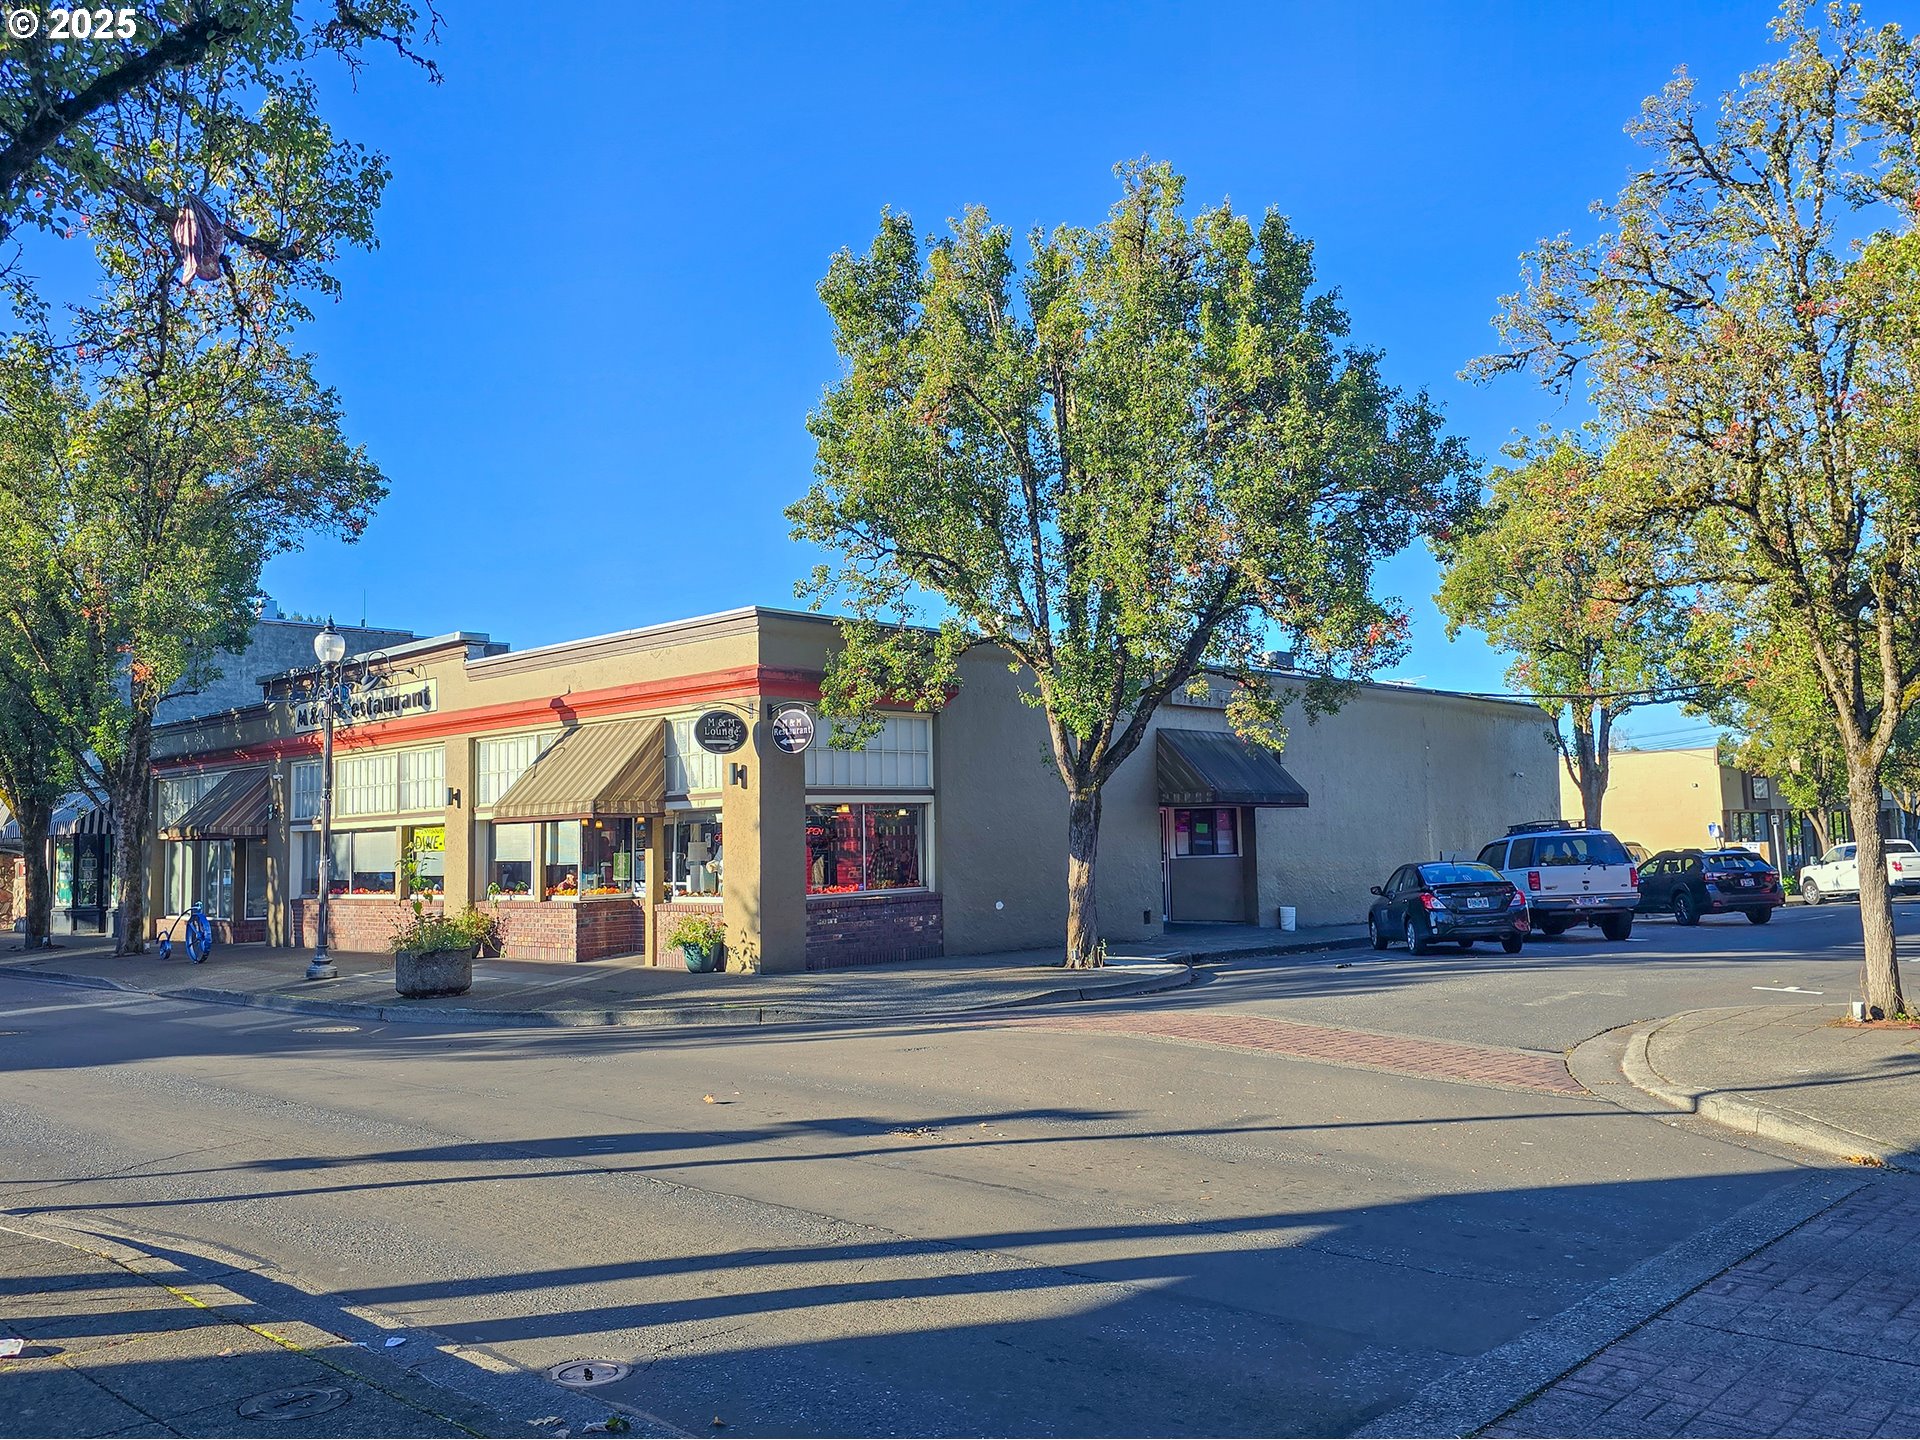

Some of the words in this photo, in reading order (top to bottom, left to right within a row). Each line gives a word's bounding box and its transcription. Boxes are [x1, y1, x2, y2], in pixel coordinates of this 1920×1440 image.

[707, 718, 715, 727] M
[718, 718, 727, 727] &
[728, 718, 736, 727] M
[704, 726, 740, 738] Lounge
